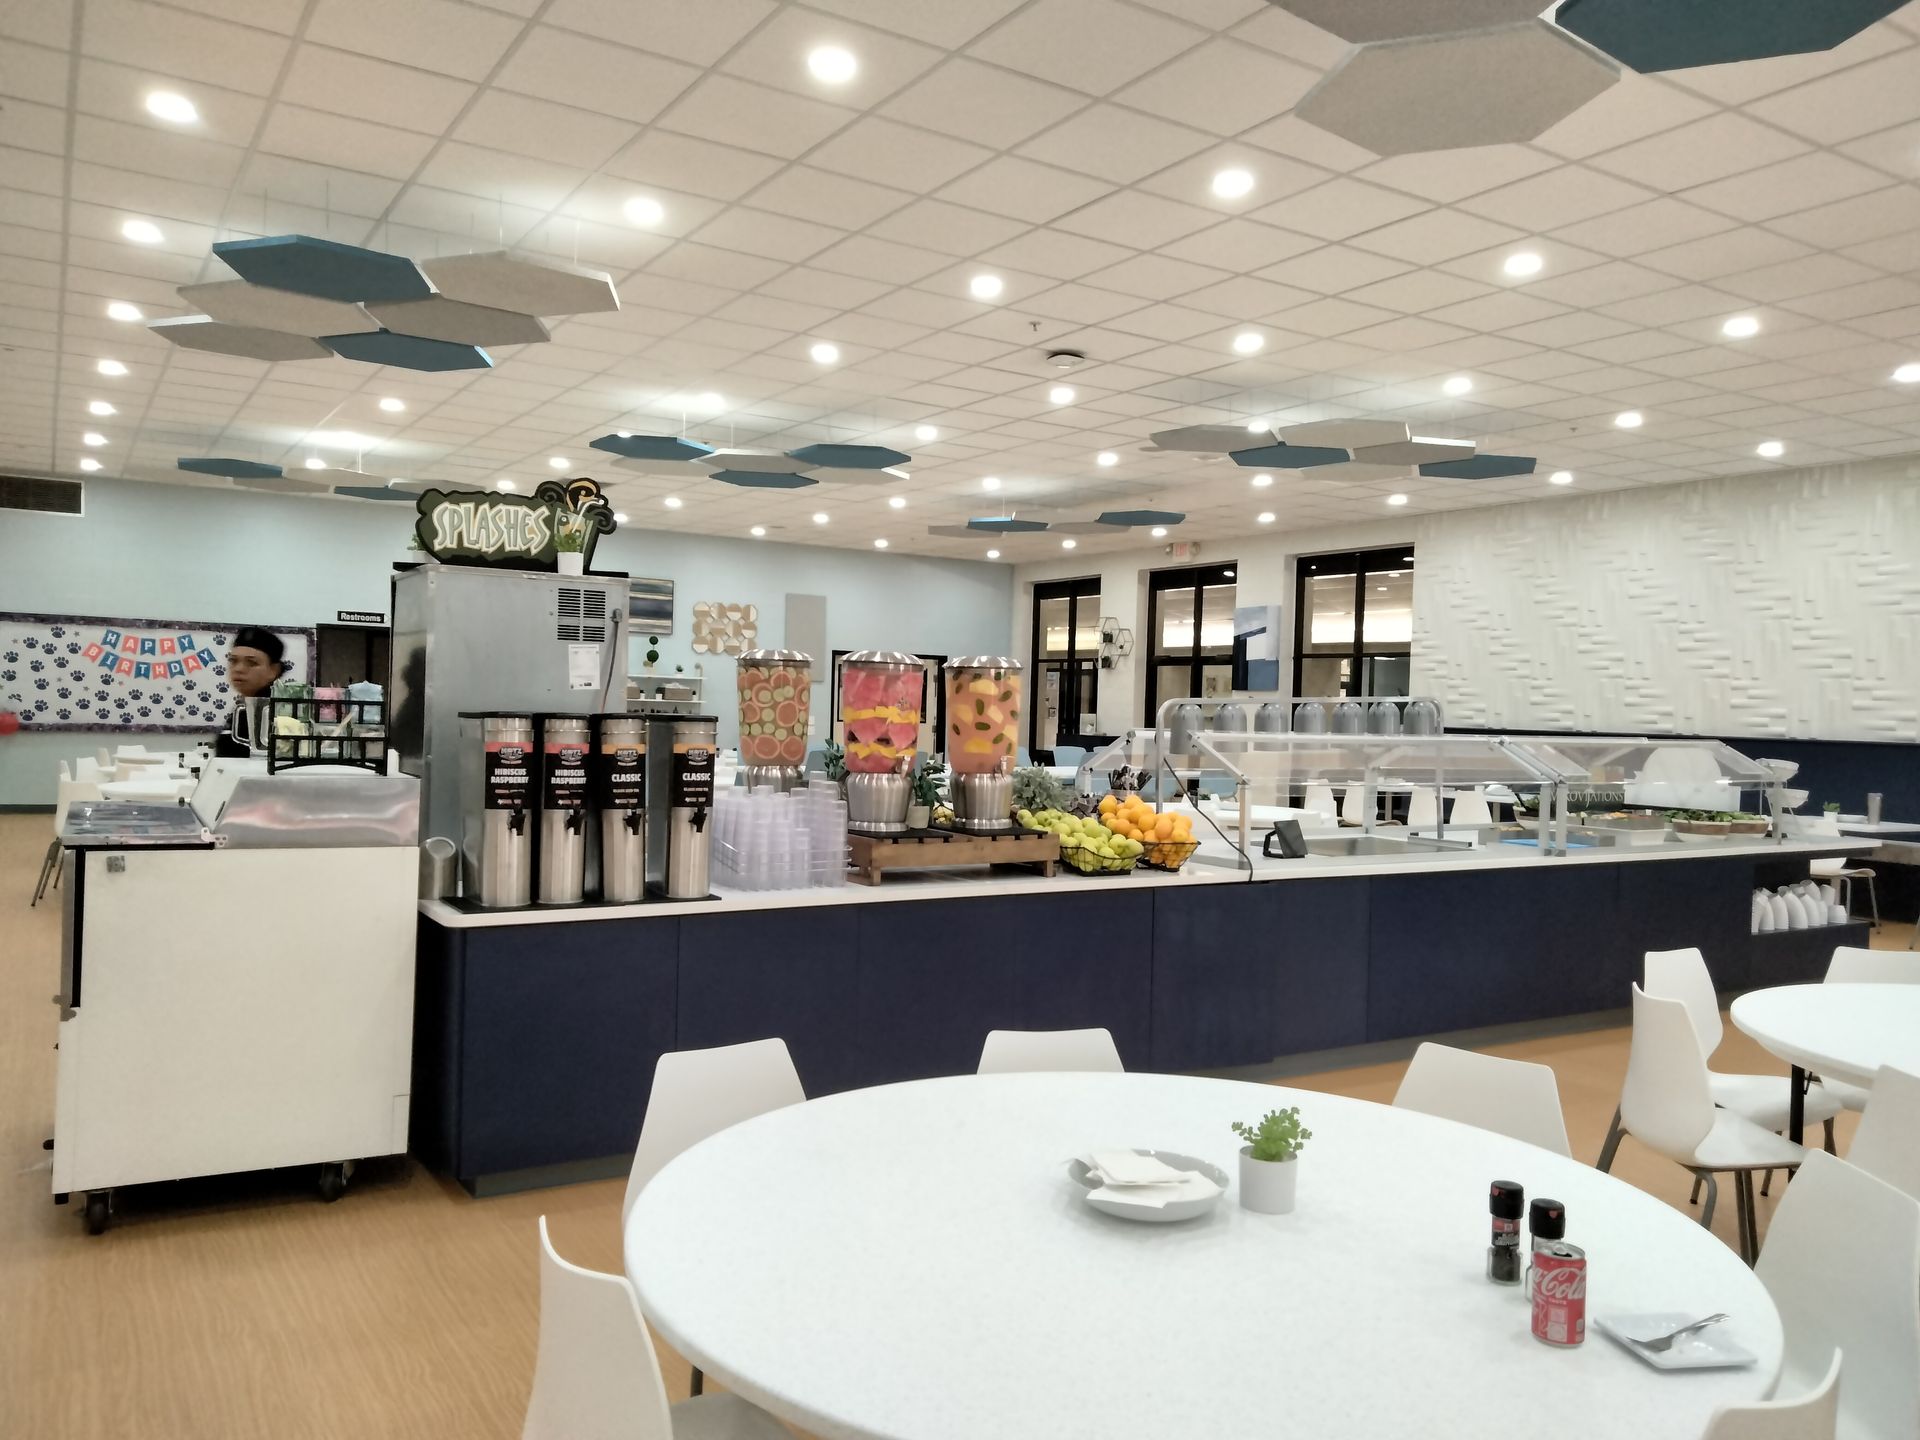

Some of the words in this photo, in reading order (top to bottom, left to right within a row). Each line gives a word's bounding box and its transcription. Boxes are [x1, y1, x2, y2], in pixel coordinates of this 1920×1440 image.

[432, 501, 552, 556] SPLASHES
[340, 612, 382, 622] Restrooms
[105, 633, 193, 651] HAPPY
[88, 647, 210, 675] BIRTHDAY
[494, 768, 527, 776] HIBISCUS
[555, 769, 585, 777] HIBISCUS
[682, 772, 711, 781] CLASSIC
[490, 776, 529, 784] RASPBERRY
[551, 777, 587, 785] RASPBERRY
[611, 773, 642, 782] CLASSIC
